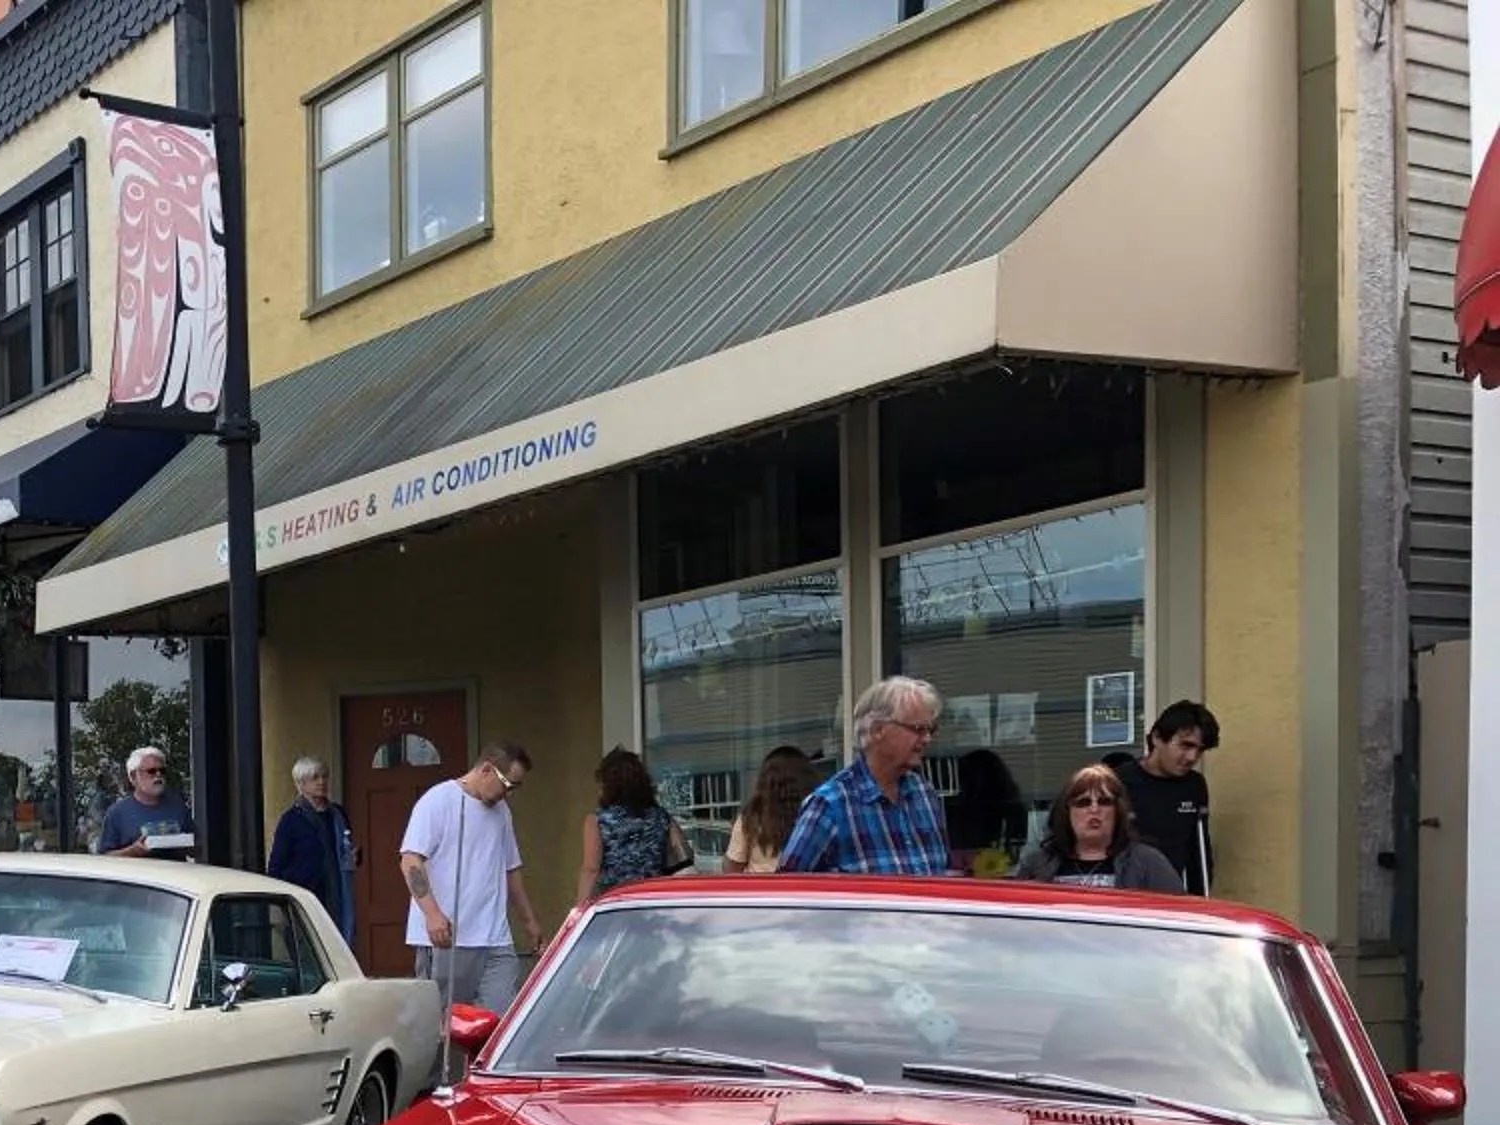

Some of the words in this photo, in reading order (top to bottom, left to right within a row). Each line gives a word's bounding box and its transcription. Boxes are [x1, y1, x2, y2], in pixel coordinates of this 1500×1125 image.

[280, 499, 360, 546] HEATING
[365, 493, 379, 518] &
[390, 477, 426, 510] AIR
[430, 420, 599, 496] CONDITIONING
[382, 706, 425, 728] 526
